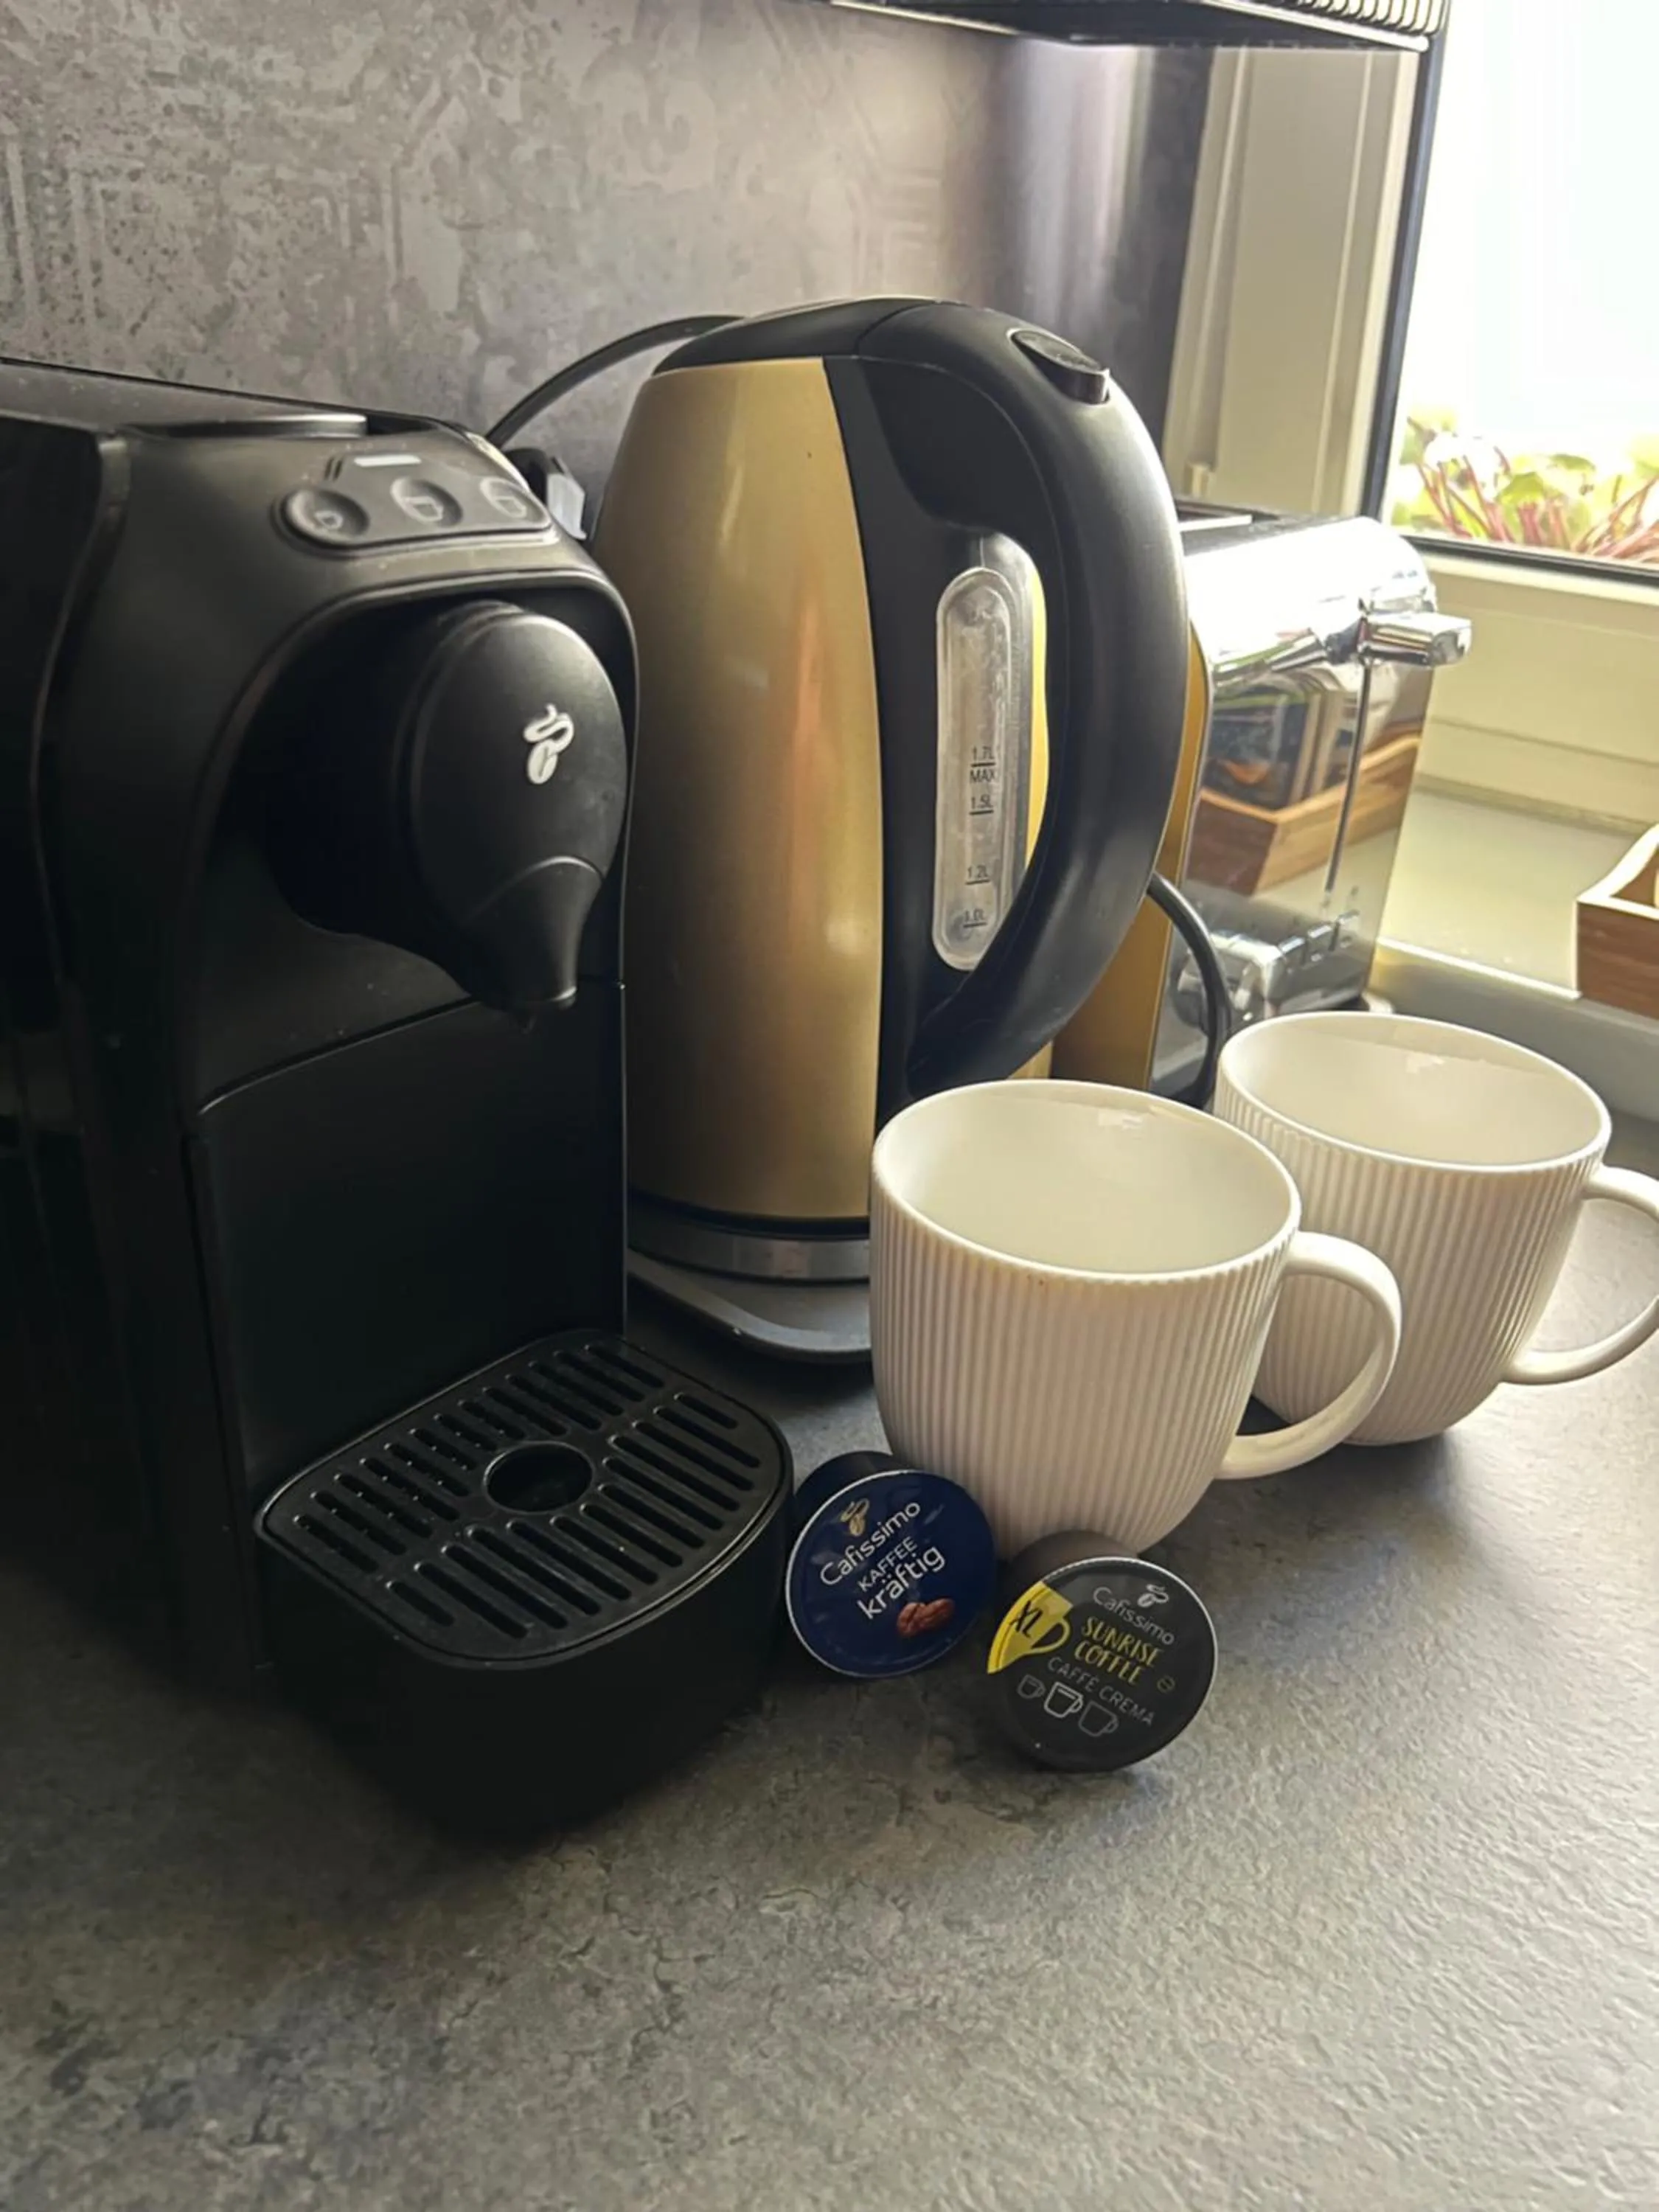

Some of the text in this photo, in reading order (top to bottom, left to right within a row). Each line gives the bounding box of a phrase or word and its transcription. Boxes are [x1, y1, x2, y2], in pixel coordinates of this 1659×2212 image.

[970, 769, 996, 783] MAX
[820, 1502, 921, 1585] Cafissimo
[858, 1536, 917, 1593] KAFFEE
[857, 1546, 945, 1620] kräftig
[1009, 1600, 1043, 1638] XL
[1093, 1587, 1175, 1646] Cafissimo
[1074, 1641, 1147, 1685] COFFEE
[1082, 1617, 1164, 1669] SUNRISE
[1099, 1686, 1155, 1727] CREMA
